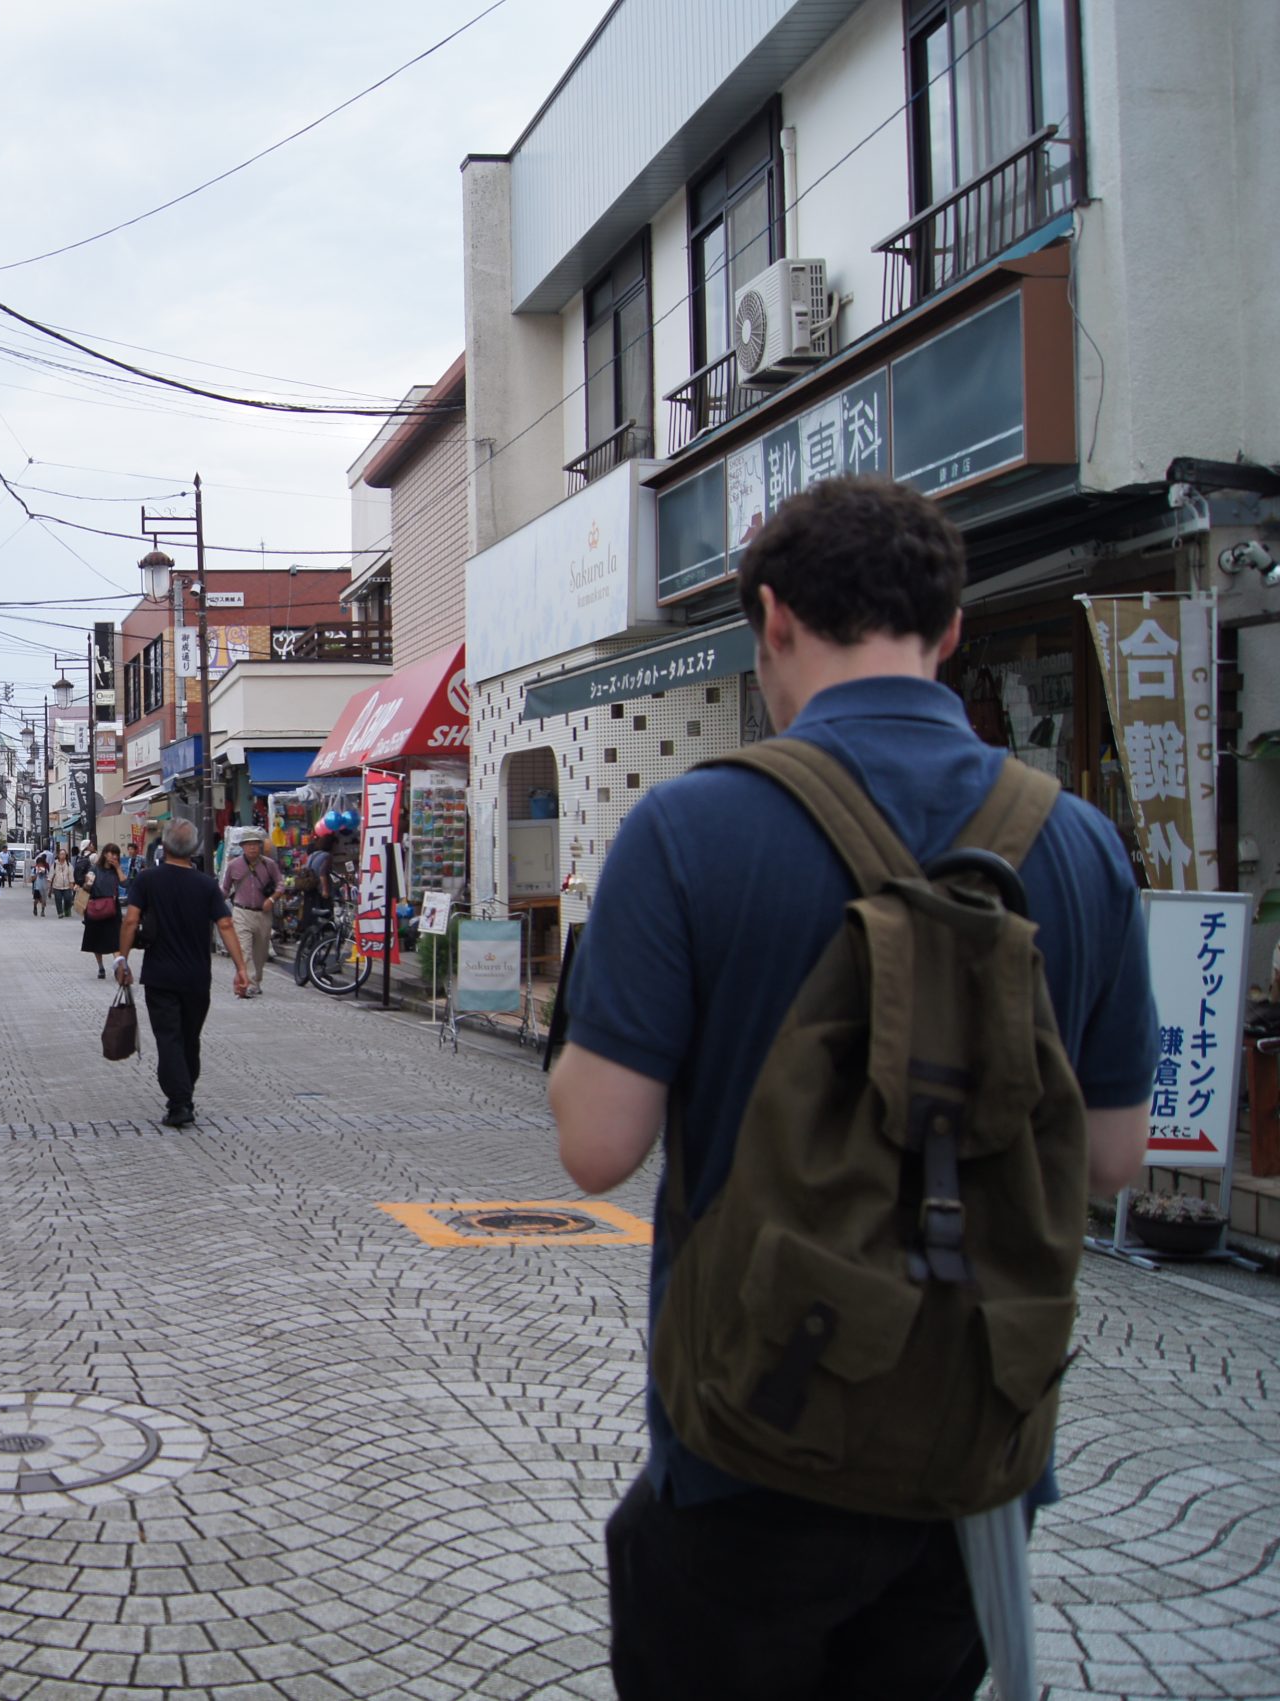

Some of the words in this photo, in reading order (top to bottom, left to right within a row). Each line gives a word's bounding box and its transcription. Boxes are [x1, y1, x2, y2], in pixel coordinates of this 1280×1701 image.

[569, 556, 604, 593] Sakura
[607, 544, 617, 575] la
[181, 634, 190, 671] 御成通り
[590, 649, 716, 699] シューズ・バッグのトータルエステ
[1188, 912, 1227, 1118] チケットキング
[1150, 1026, 1184, 1118] 鎌倉店
[1149, 1124, 1192, 1138] すぐそこ
